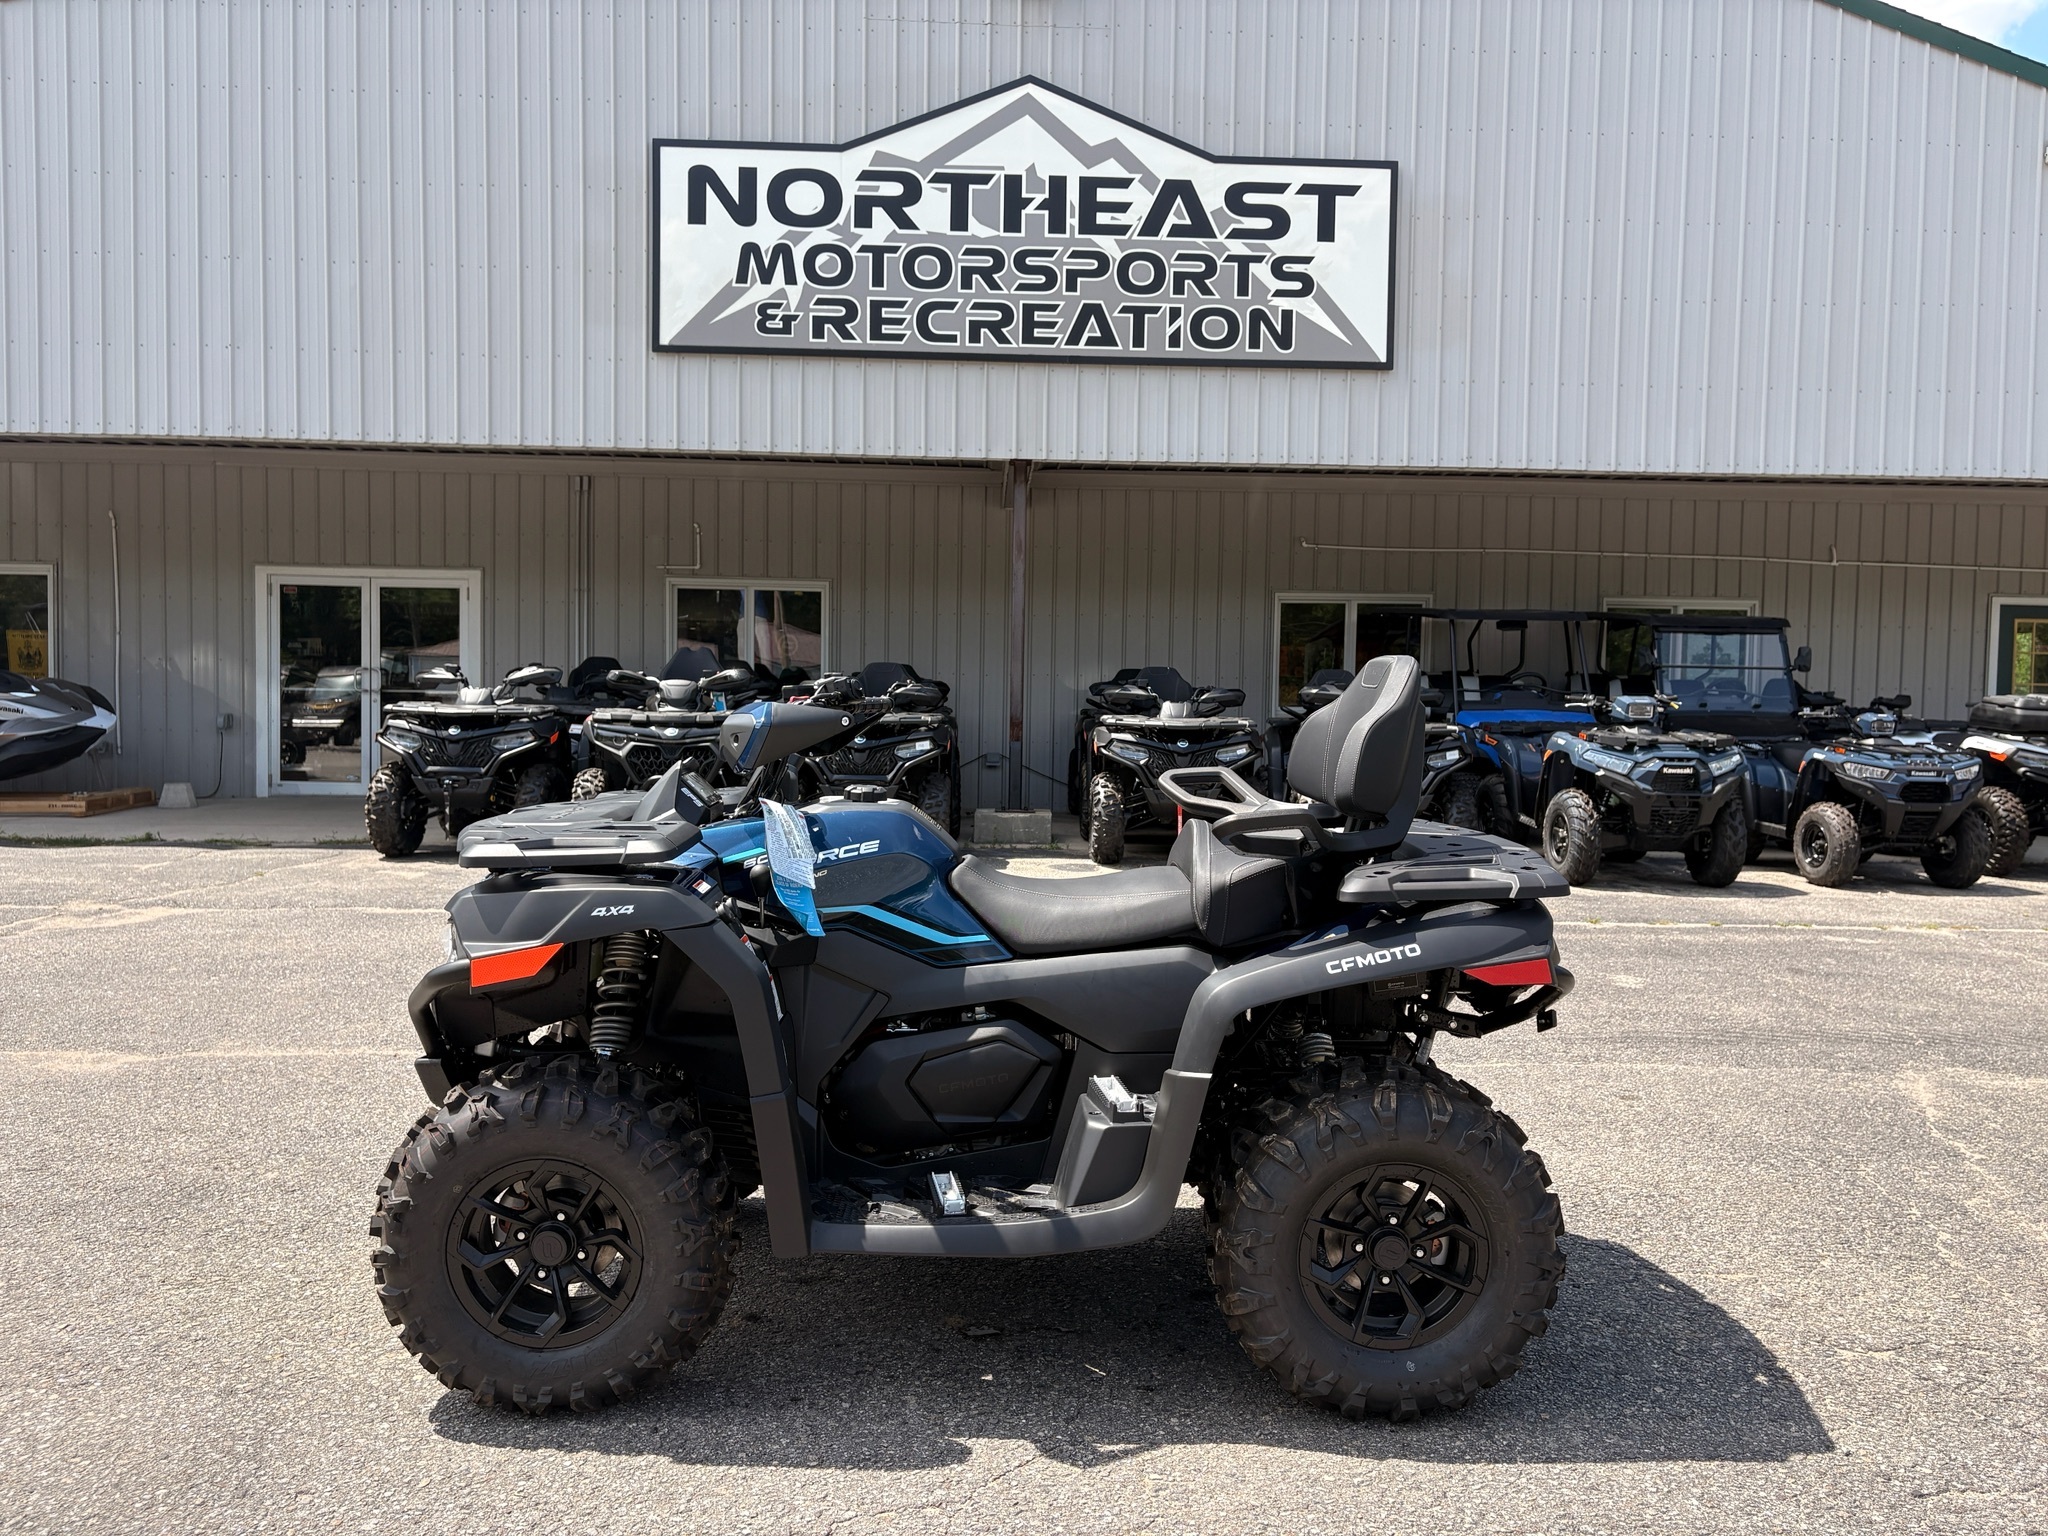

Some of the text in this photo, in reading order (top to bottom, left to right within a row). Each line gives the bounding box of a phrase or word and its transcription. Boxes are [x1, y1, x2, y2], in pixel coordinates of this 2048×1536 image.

[687, 164, 1362, 243] NORTHEAST
[735, 242, 1315, 298] MOTORSPORTS
[1663, 766, 1694, 775] Kawasaki
[680, 787, 704, 808] EPS
[816, 839, 881, 864] RCE
[1325, 943, 1422, 975] CFMOTO
[938, 1072, 1009, 1094] CFMOTO
